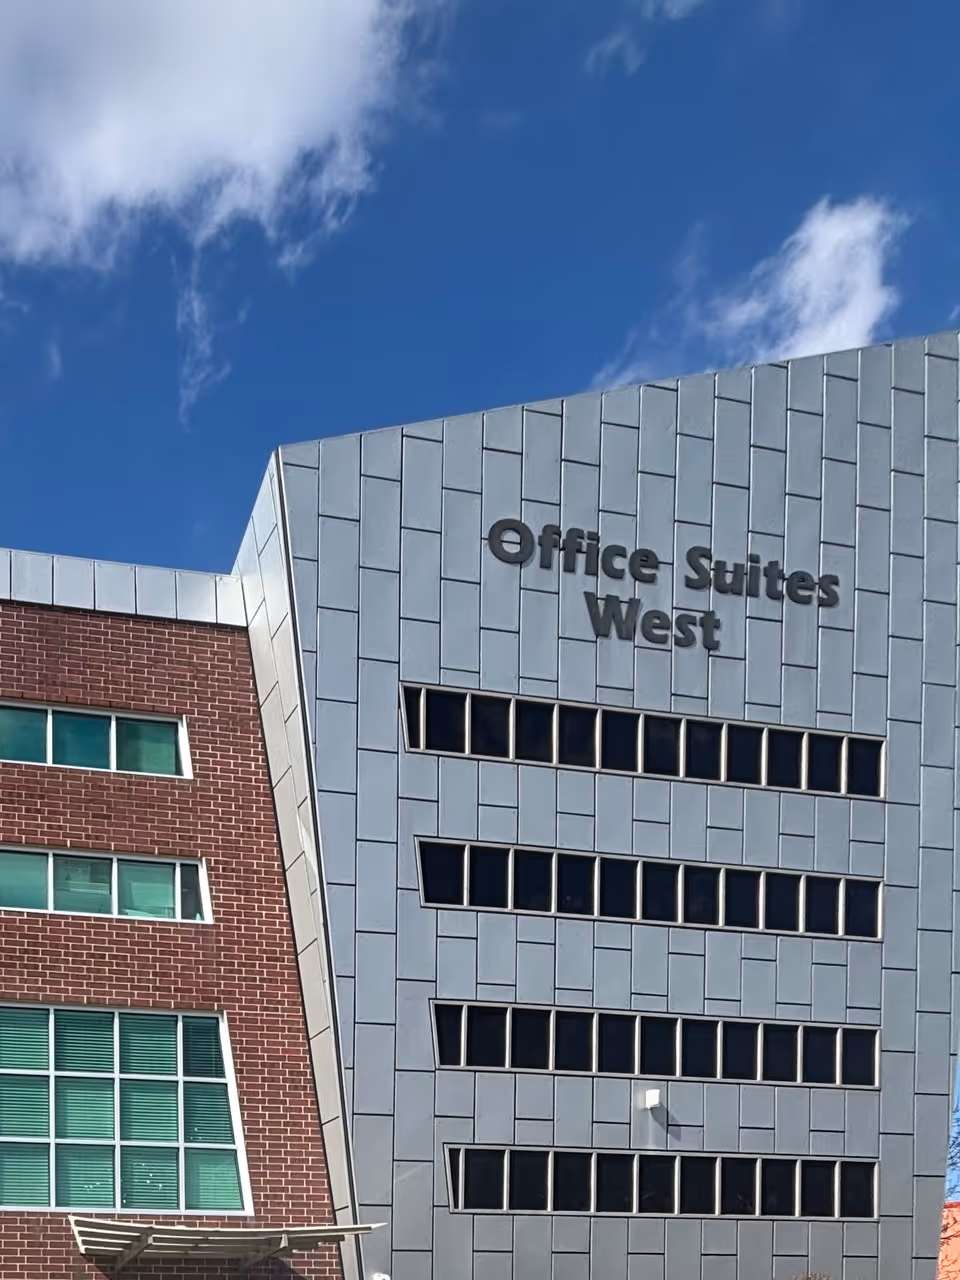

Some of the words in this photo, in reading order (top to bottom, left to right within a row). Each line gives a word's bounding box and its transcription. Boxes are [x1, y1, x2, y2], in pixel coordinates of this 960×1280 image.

[488, 518, 659, 583] Office
[685, 546, 840, 607] Suites
[583, 591, 721, 650] West
